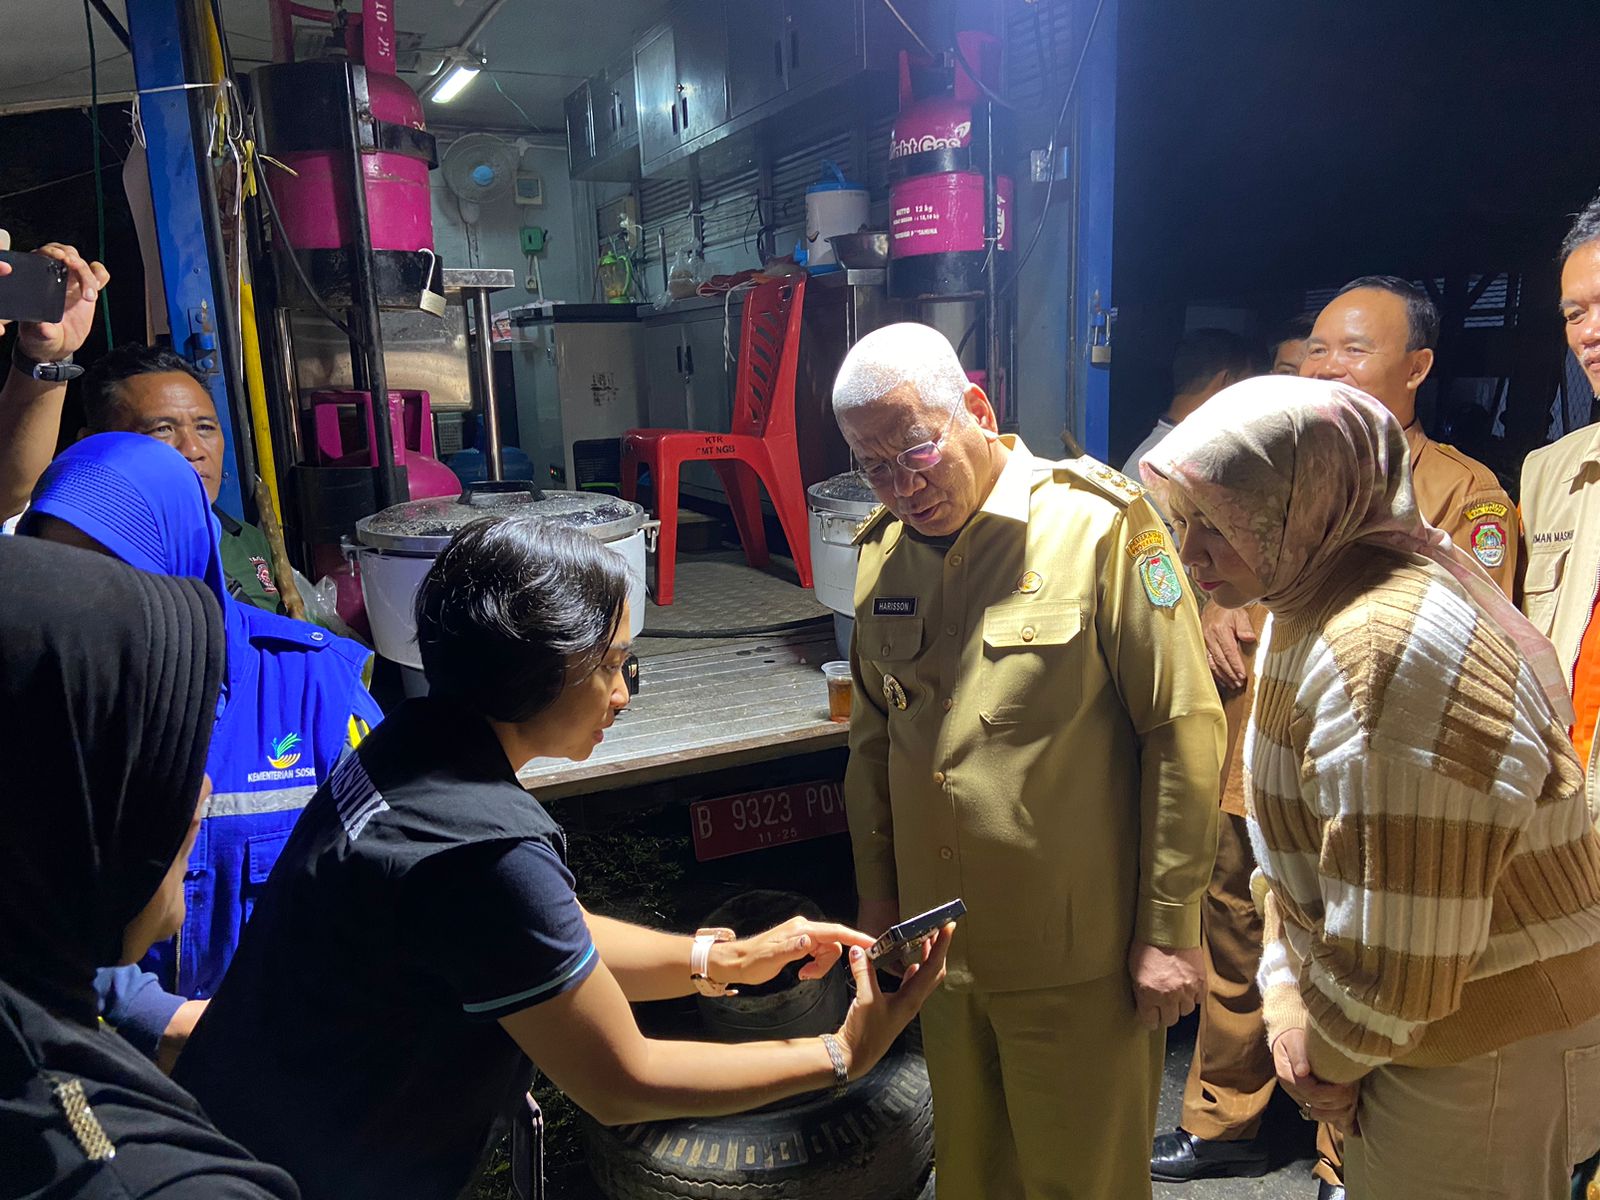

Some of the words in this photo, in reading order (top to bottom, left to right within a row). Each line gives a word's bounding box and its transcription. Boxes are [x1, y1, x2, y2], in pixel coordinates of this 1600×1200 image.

[704, 435, 724, 445] KTR
[716, 445, 736, 454] NGB
[878, 602, 910, 611] HARISSON
[248, 769, 294, 782] KEMENTERIAN
[697, 805, 713, 839] B
[732, 791, 793, 831] 9323
